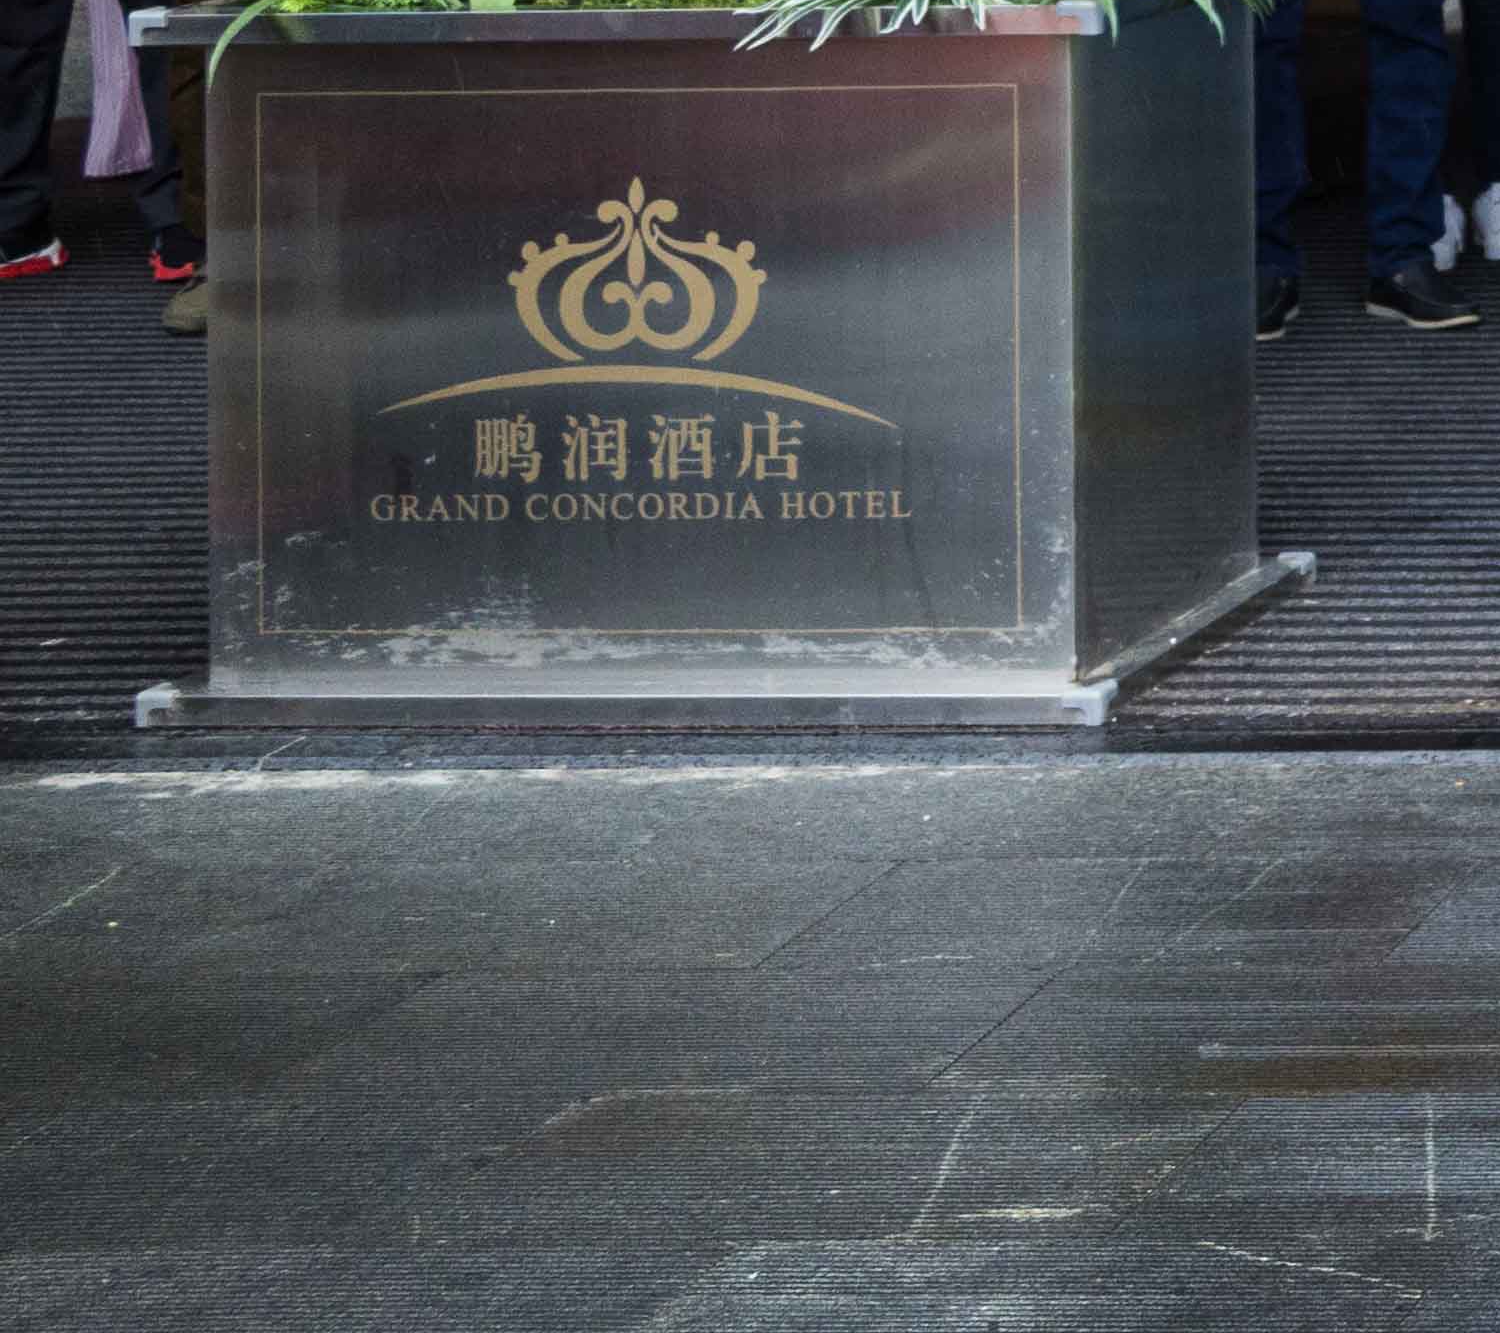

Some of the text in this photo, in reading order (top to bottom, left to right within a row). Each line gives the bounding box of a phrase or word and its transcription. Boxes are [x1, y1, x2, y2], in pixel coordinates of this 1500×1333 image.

[473, 412, 805, 484] 鹏润酒店
[370, 489, 912, 523] GRAND CONCORDIA HOTEL
